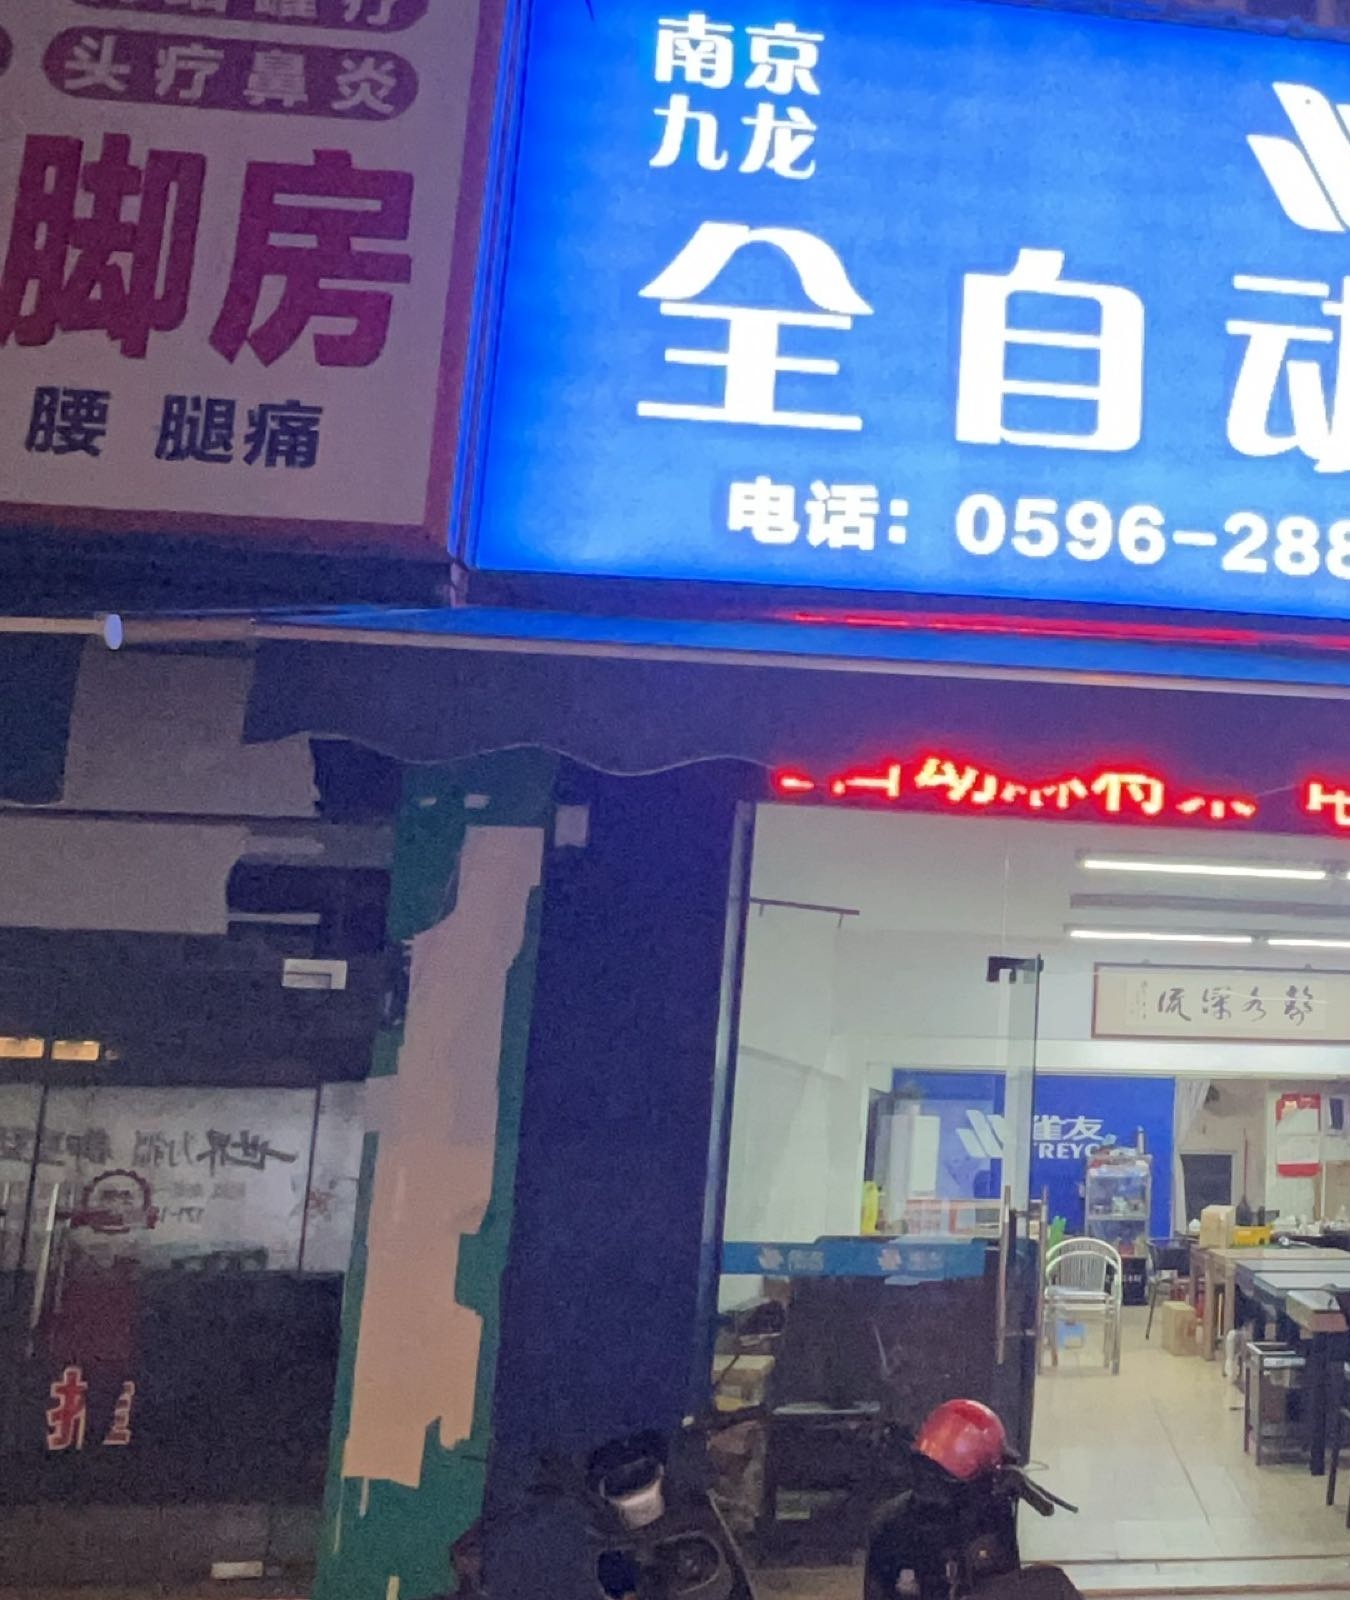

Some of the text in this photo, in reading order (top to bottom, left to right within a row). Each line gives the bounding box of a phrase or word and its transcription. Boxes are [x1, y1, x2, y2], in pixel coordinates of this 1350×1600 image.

[64, 35, 396, 115] 头疗鼻炎
[654, 14, 825, 96] 南京
[649, 94, 819, 180] 九龙
[1034, 1142, 1094, 1160] REYO
